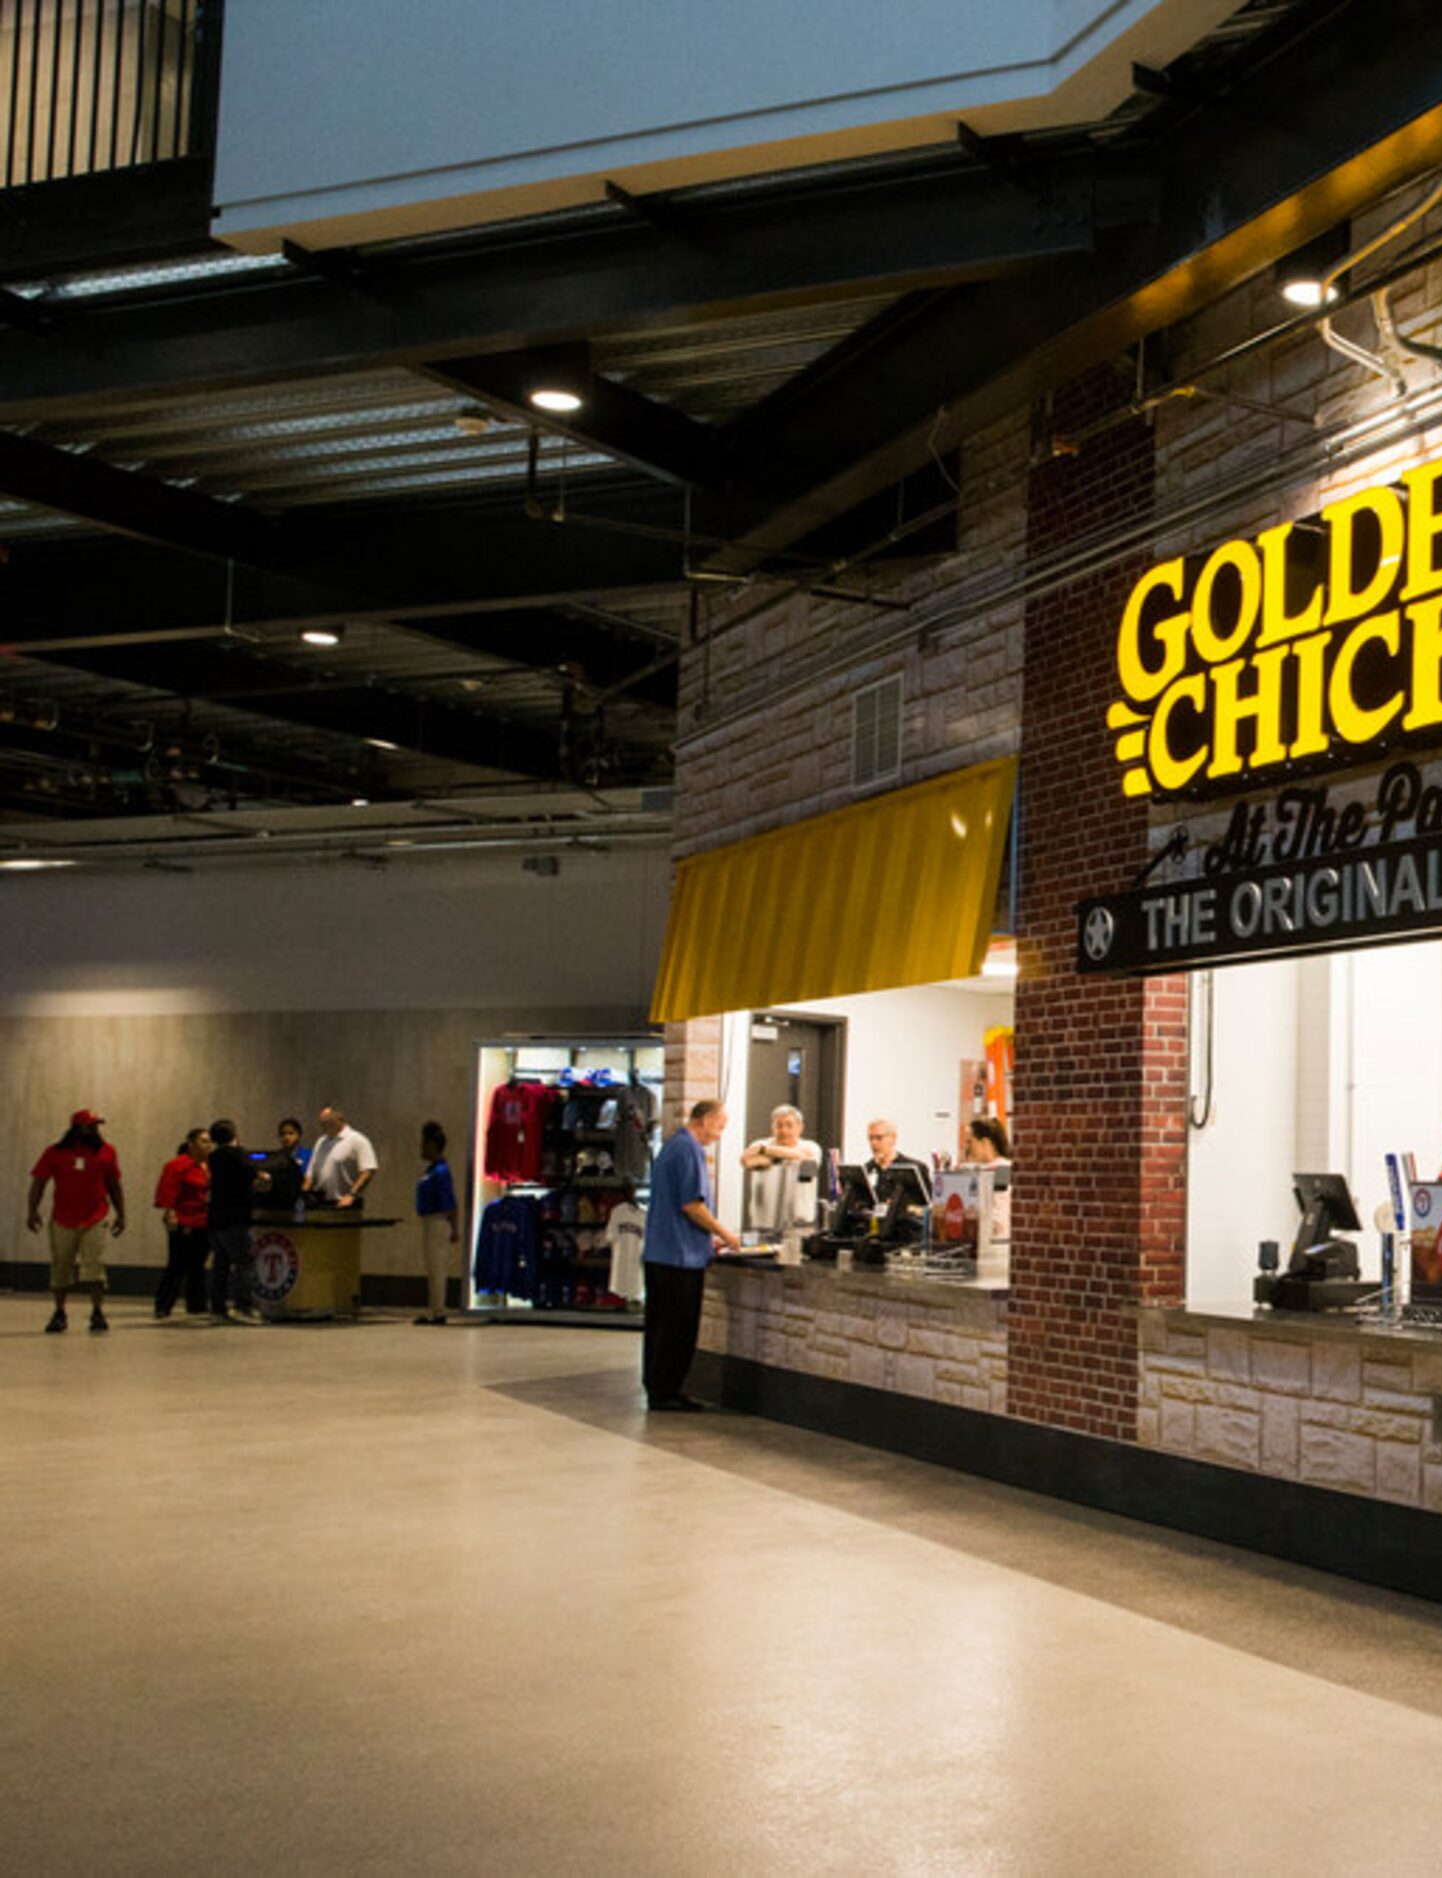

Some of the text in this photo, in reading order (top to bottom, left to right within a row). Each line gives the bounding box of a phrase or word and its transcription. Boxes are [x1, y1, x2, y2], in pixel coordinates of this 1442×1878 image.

[1204, 800, 1268, 875] At
[1274, 787, 1366, 861] The
[1142, 888, 1217, 951] THE
